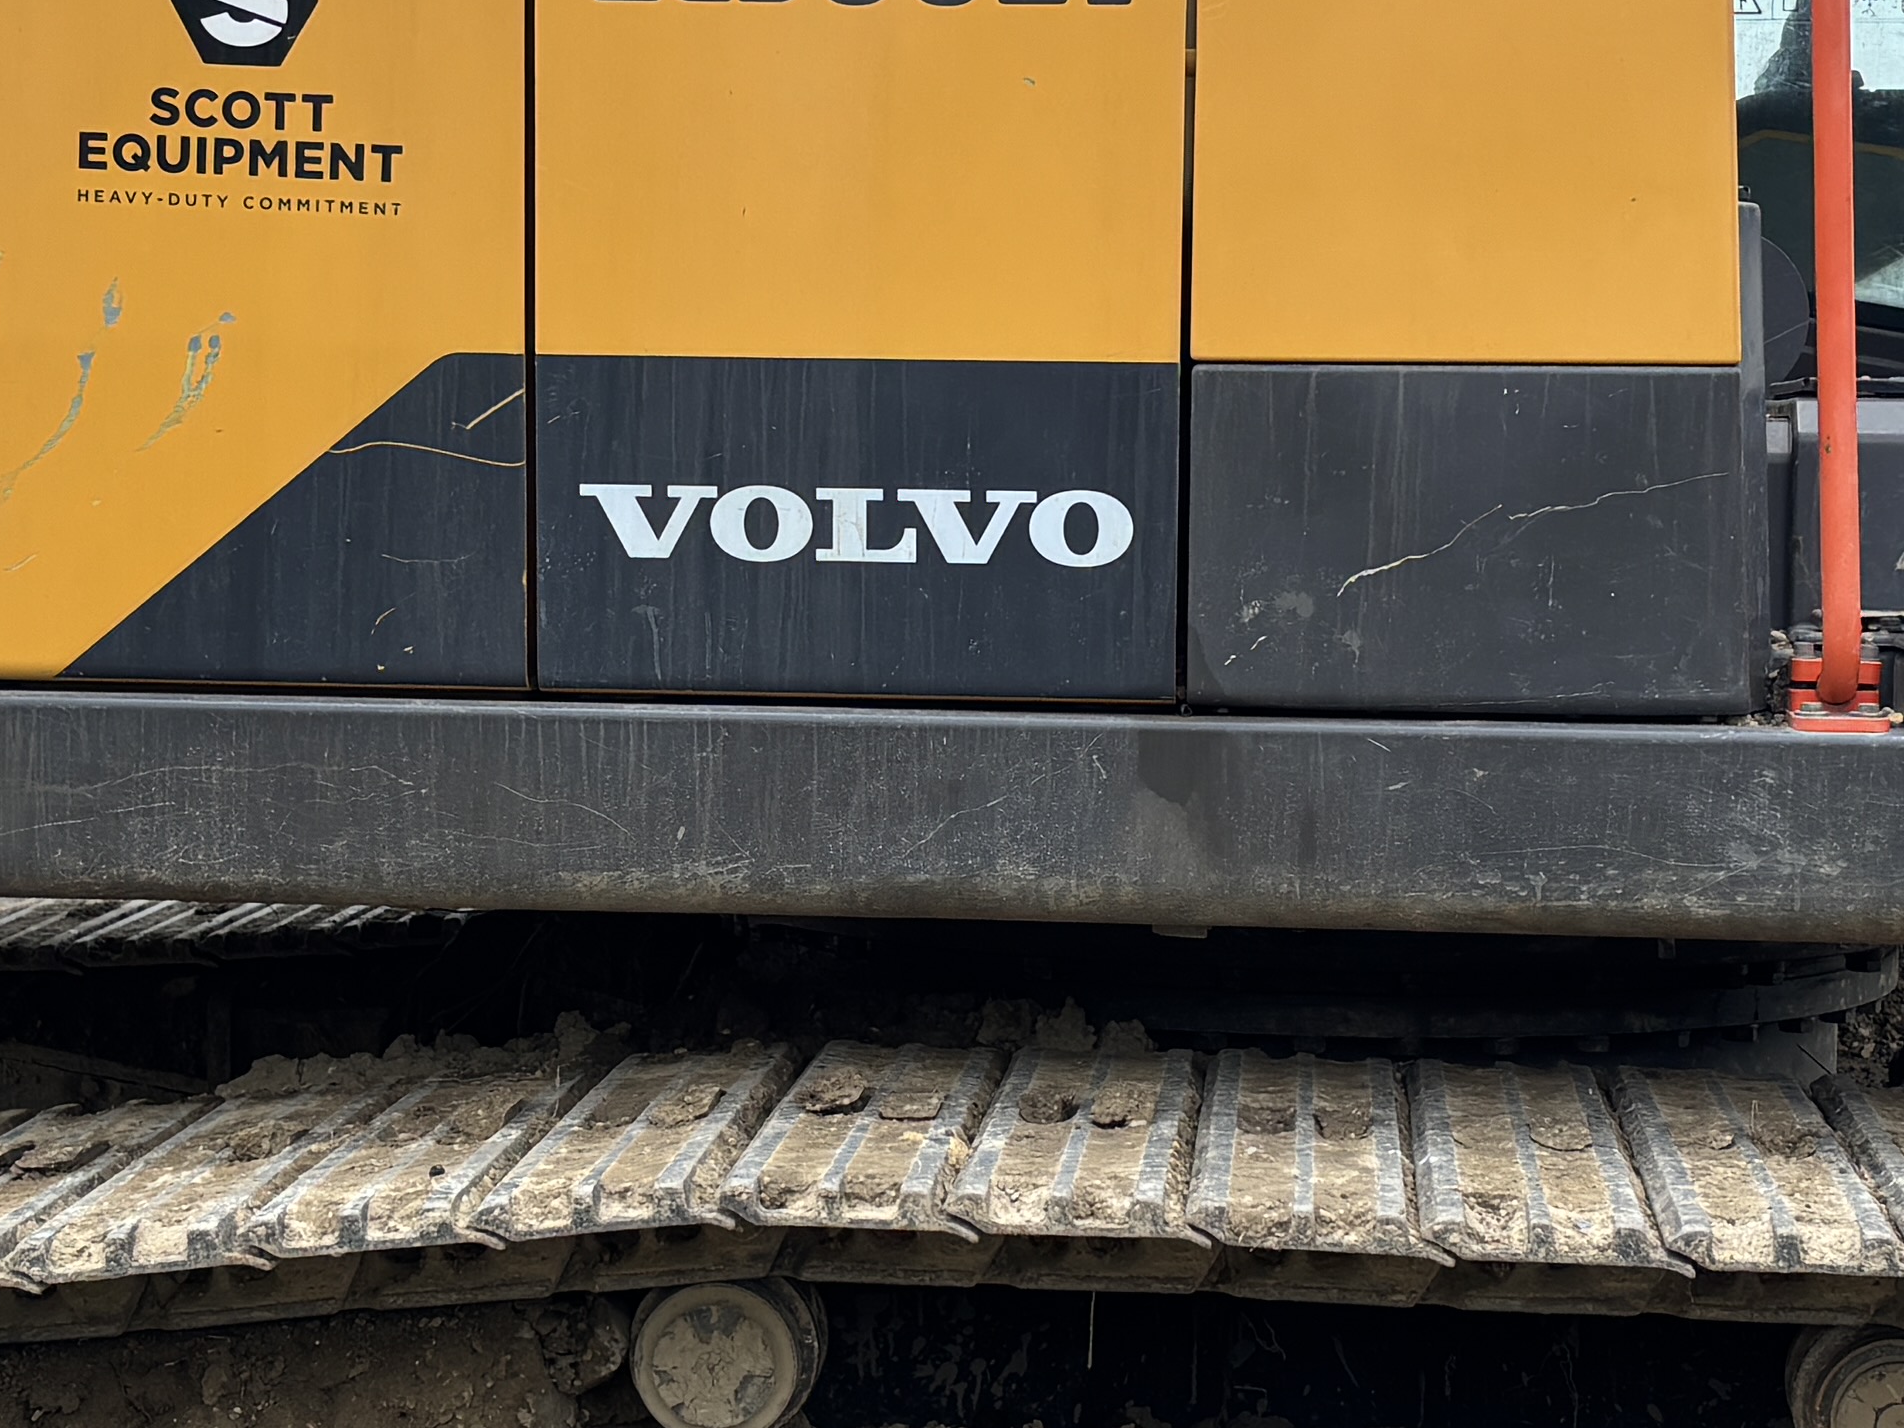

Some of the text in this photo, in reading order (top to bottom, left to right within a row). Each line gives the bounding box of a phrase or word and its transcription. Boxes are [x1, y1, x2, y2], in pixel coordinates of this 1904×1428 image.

[149, 87, 334, 132] SCOTT
[78, 131, 404, 183] EQUIPMENT
[77, 188, 402, 216] HEAVY-DUTY COMMITMENT
[579, 483, 1134, 568] VOLVO
